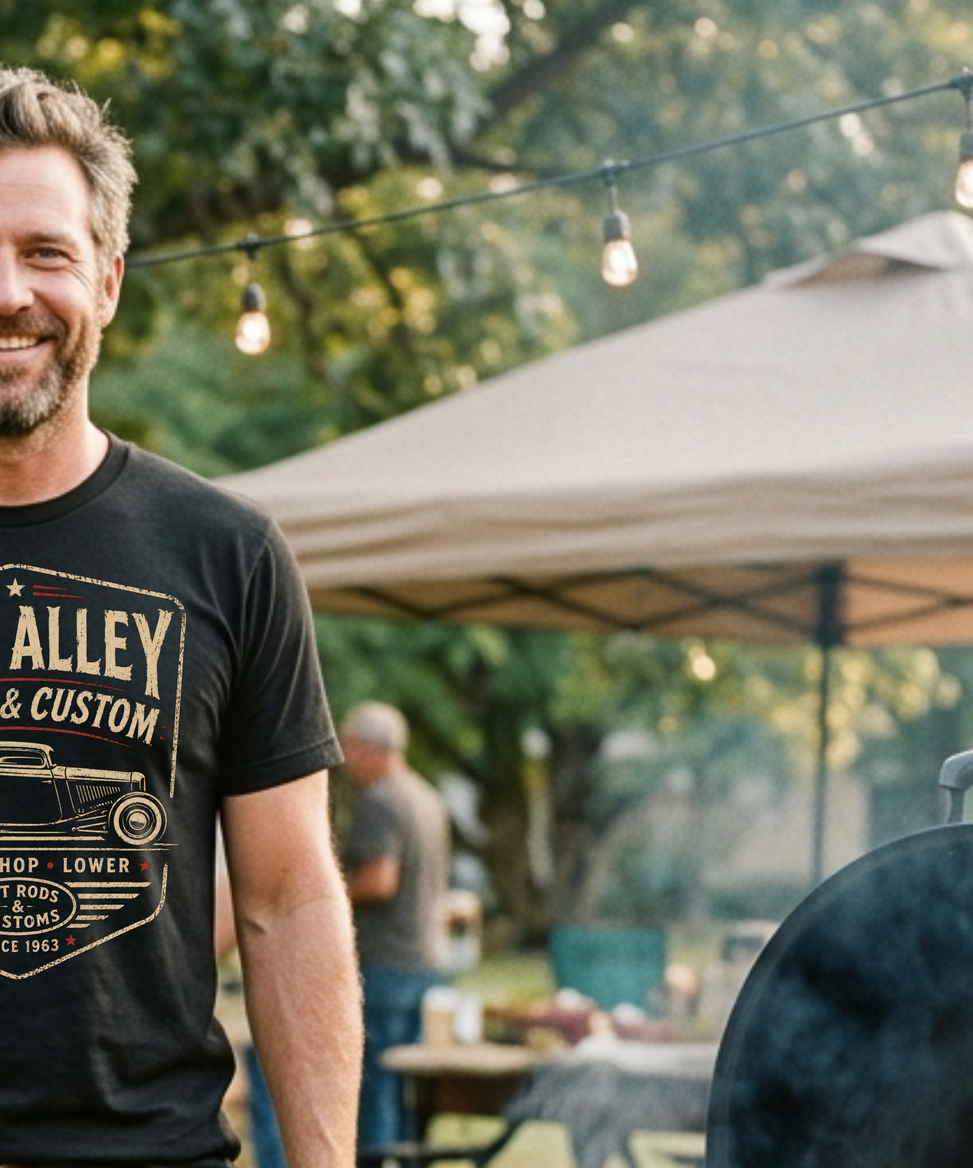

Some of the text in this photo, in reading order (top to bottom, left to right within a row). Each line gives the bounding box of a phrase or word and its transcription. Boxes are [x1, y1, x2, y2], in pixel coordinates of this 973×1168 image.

[8, 605, 174, 700] ALLEY
[0, 687, 22, 719] &
[30, 686, 160, 746] CUSTOM
[63, 857, 130, 873] LOWER
[16, 884, 60, 904] RODS
[12, 900, 24, 913] &
[25, 938, 59, 953] 1963
